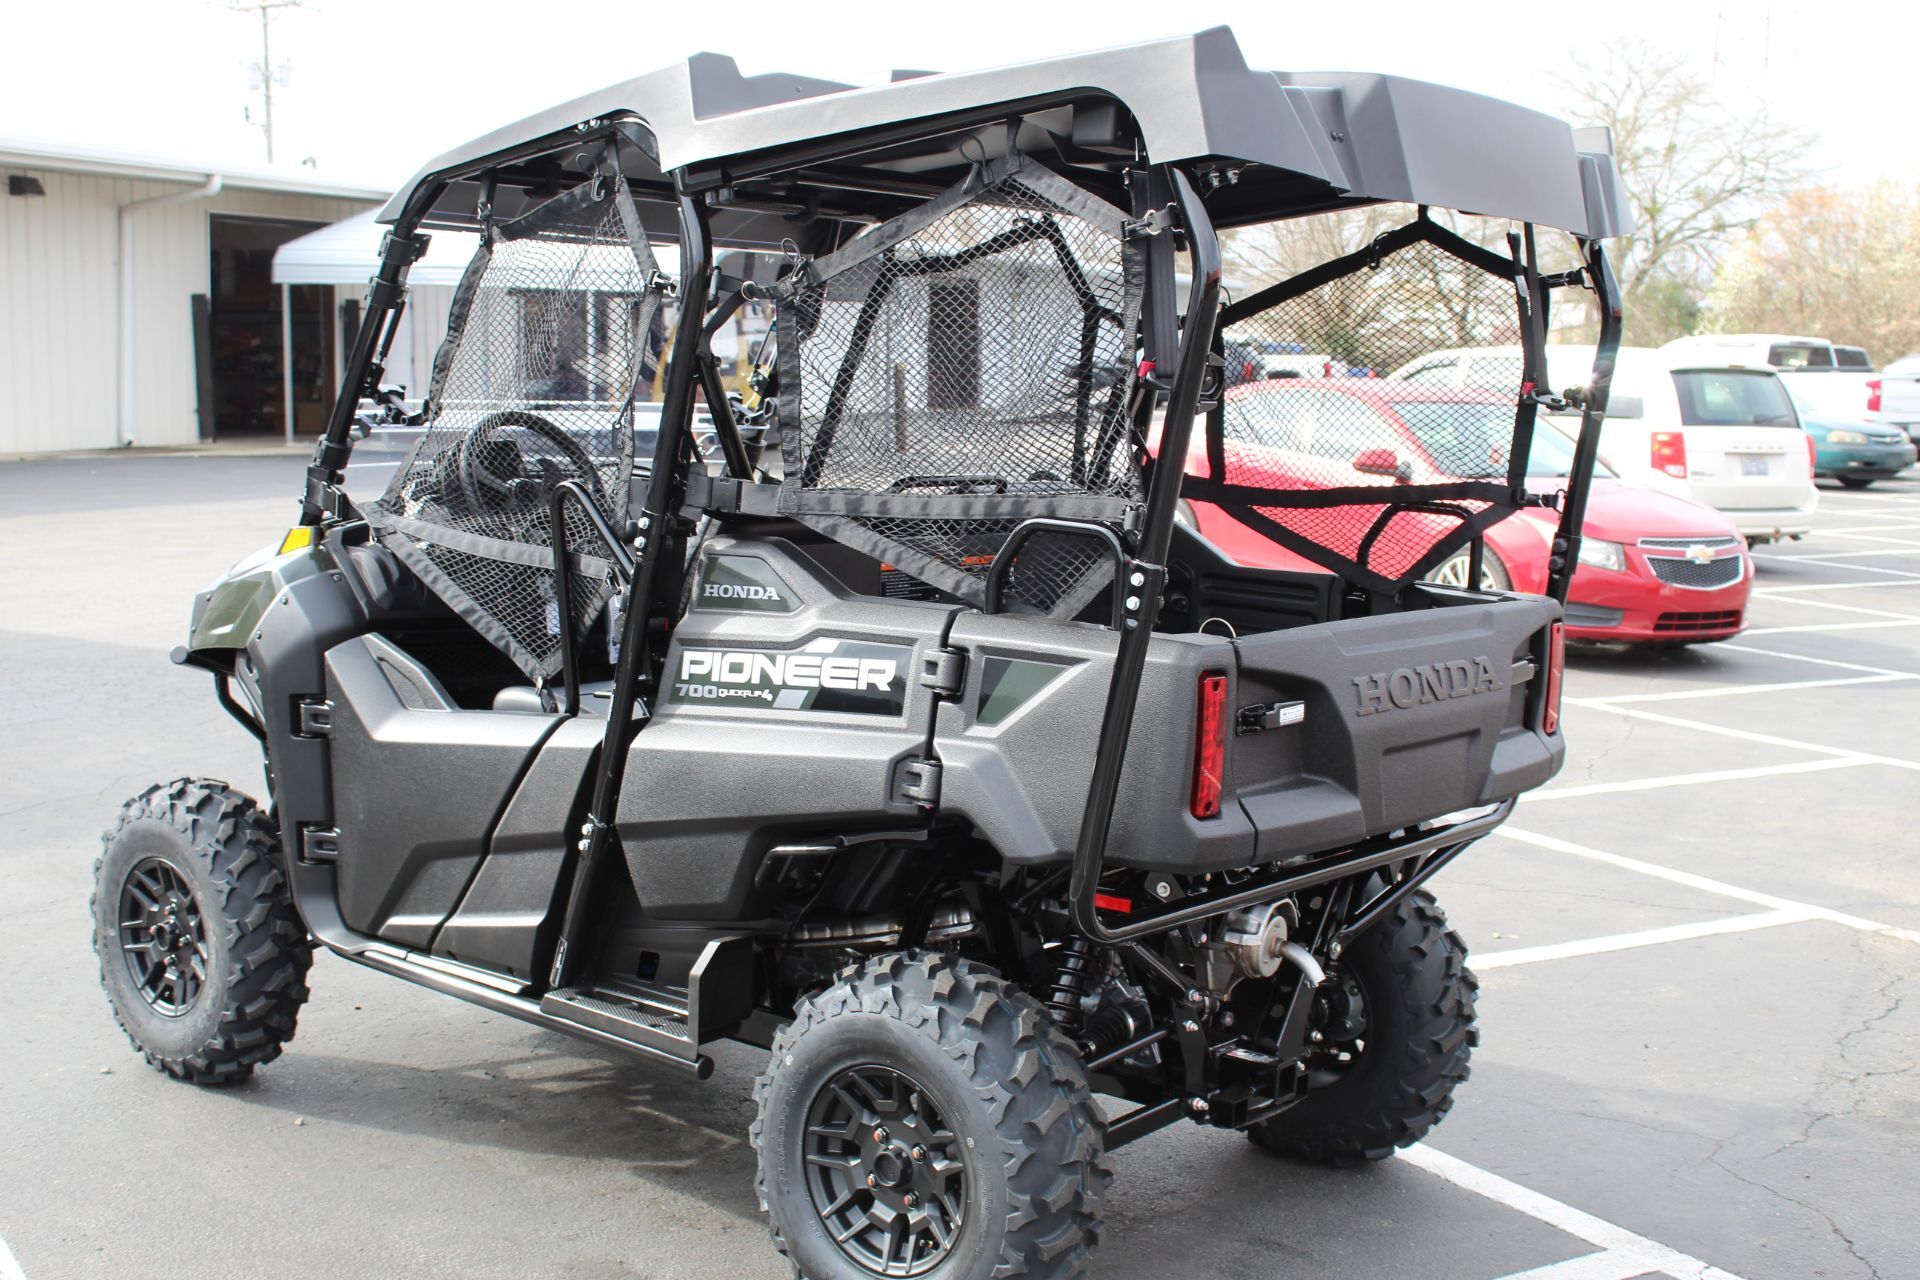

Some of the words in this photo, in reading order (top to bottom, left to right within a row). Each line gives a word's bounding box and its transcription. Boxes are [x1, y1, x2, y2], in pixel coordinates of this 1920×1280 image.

[704, 584, 780, 600] HONDA
[681, 650, 896, 691] PIONEER
[675, 684, 717, 698] 700
[1353, 656, 1502, 715] HONDA
